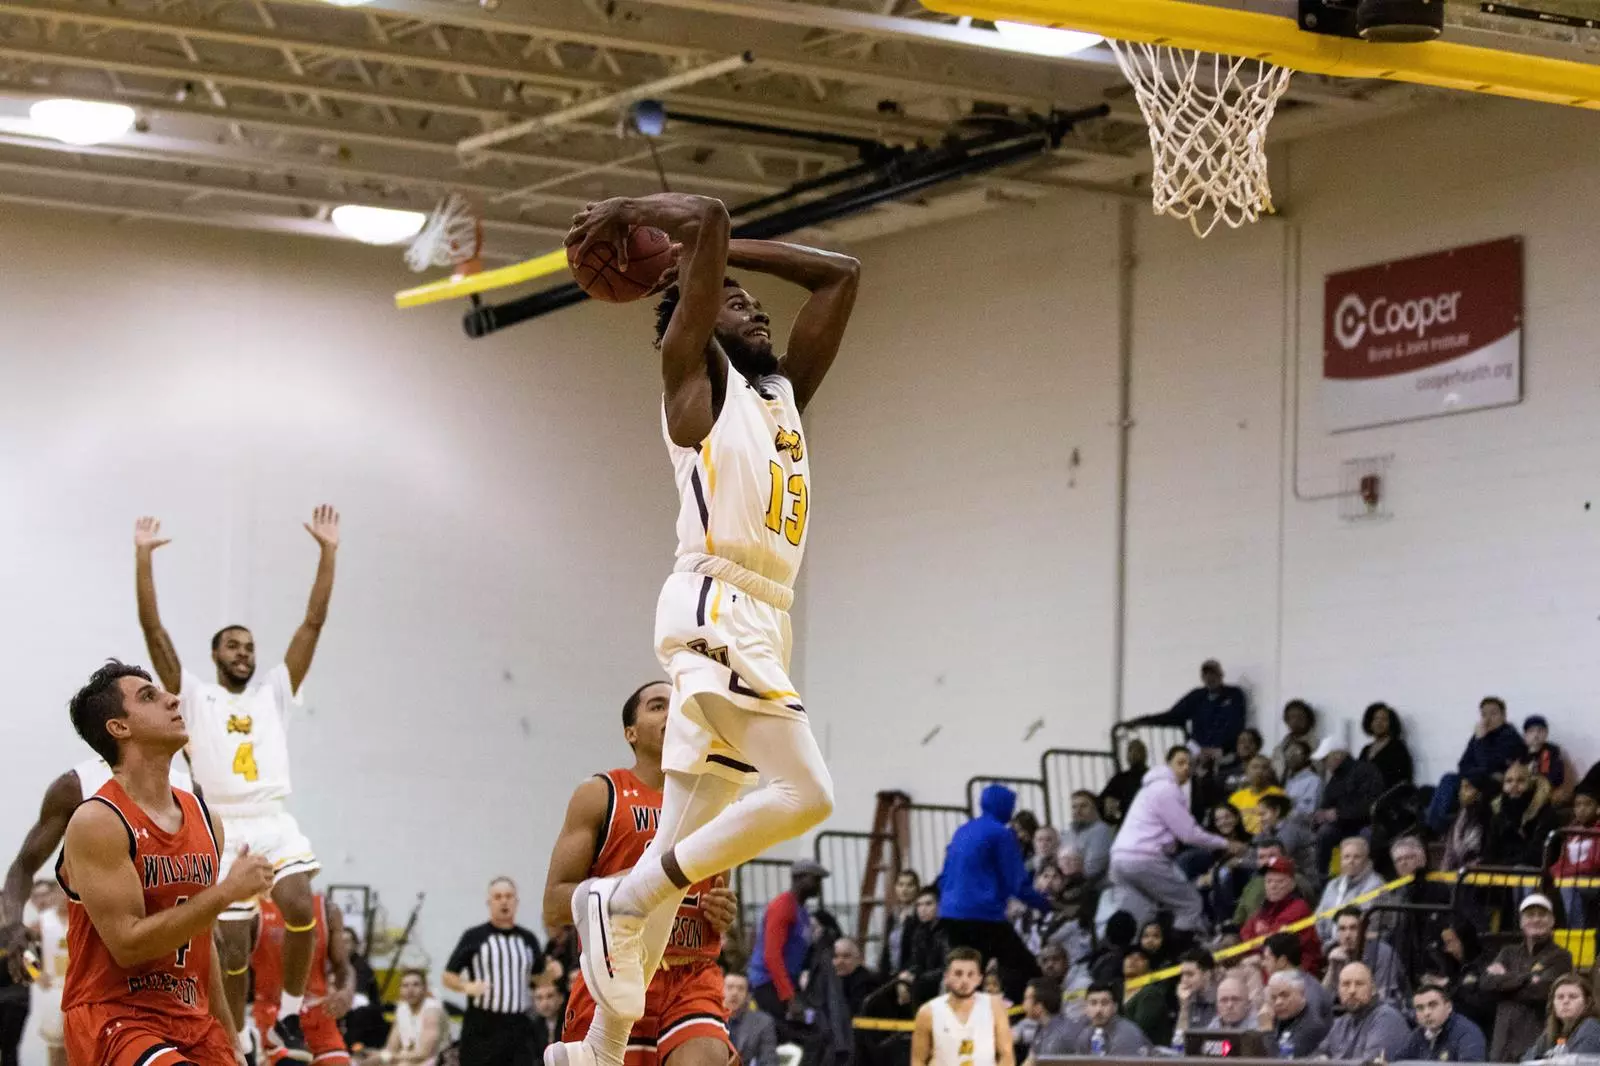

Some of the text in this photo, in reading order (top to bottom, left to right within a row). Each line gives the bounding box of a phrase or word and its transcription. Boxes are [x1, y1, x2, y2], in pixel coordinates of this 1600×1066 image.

[1369, 291, 1462, 338] Cooper
[765, 459, 808, 546] 13
[232, 741, 259, 783] 4
[142, 853, 214, 889] WILLIAM
